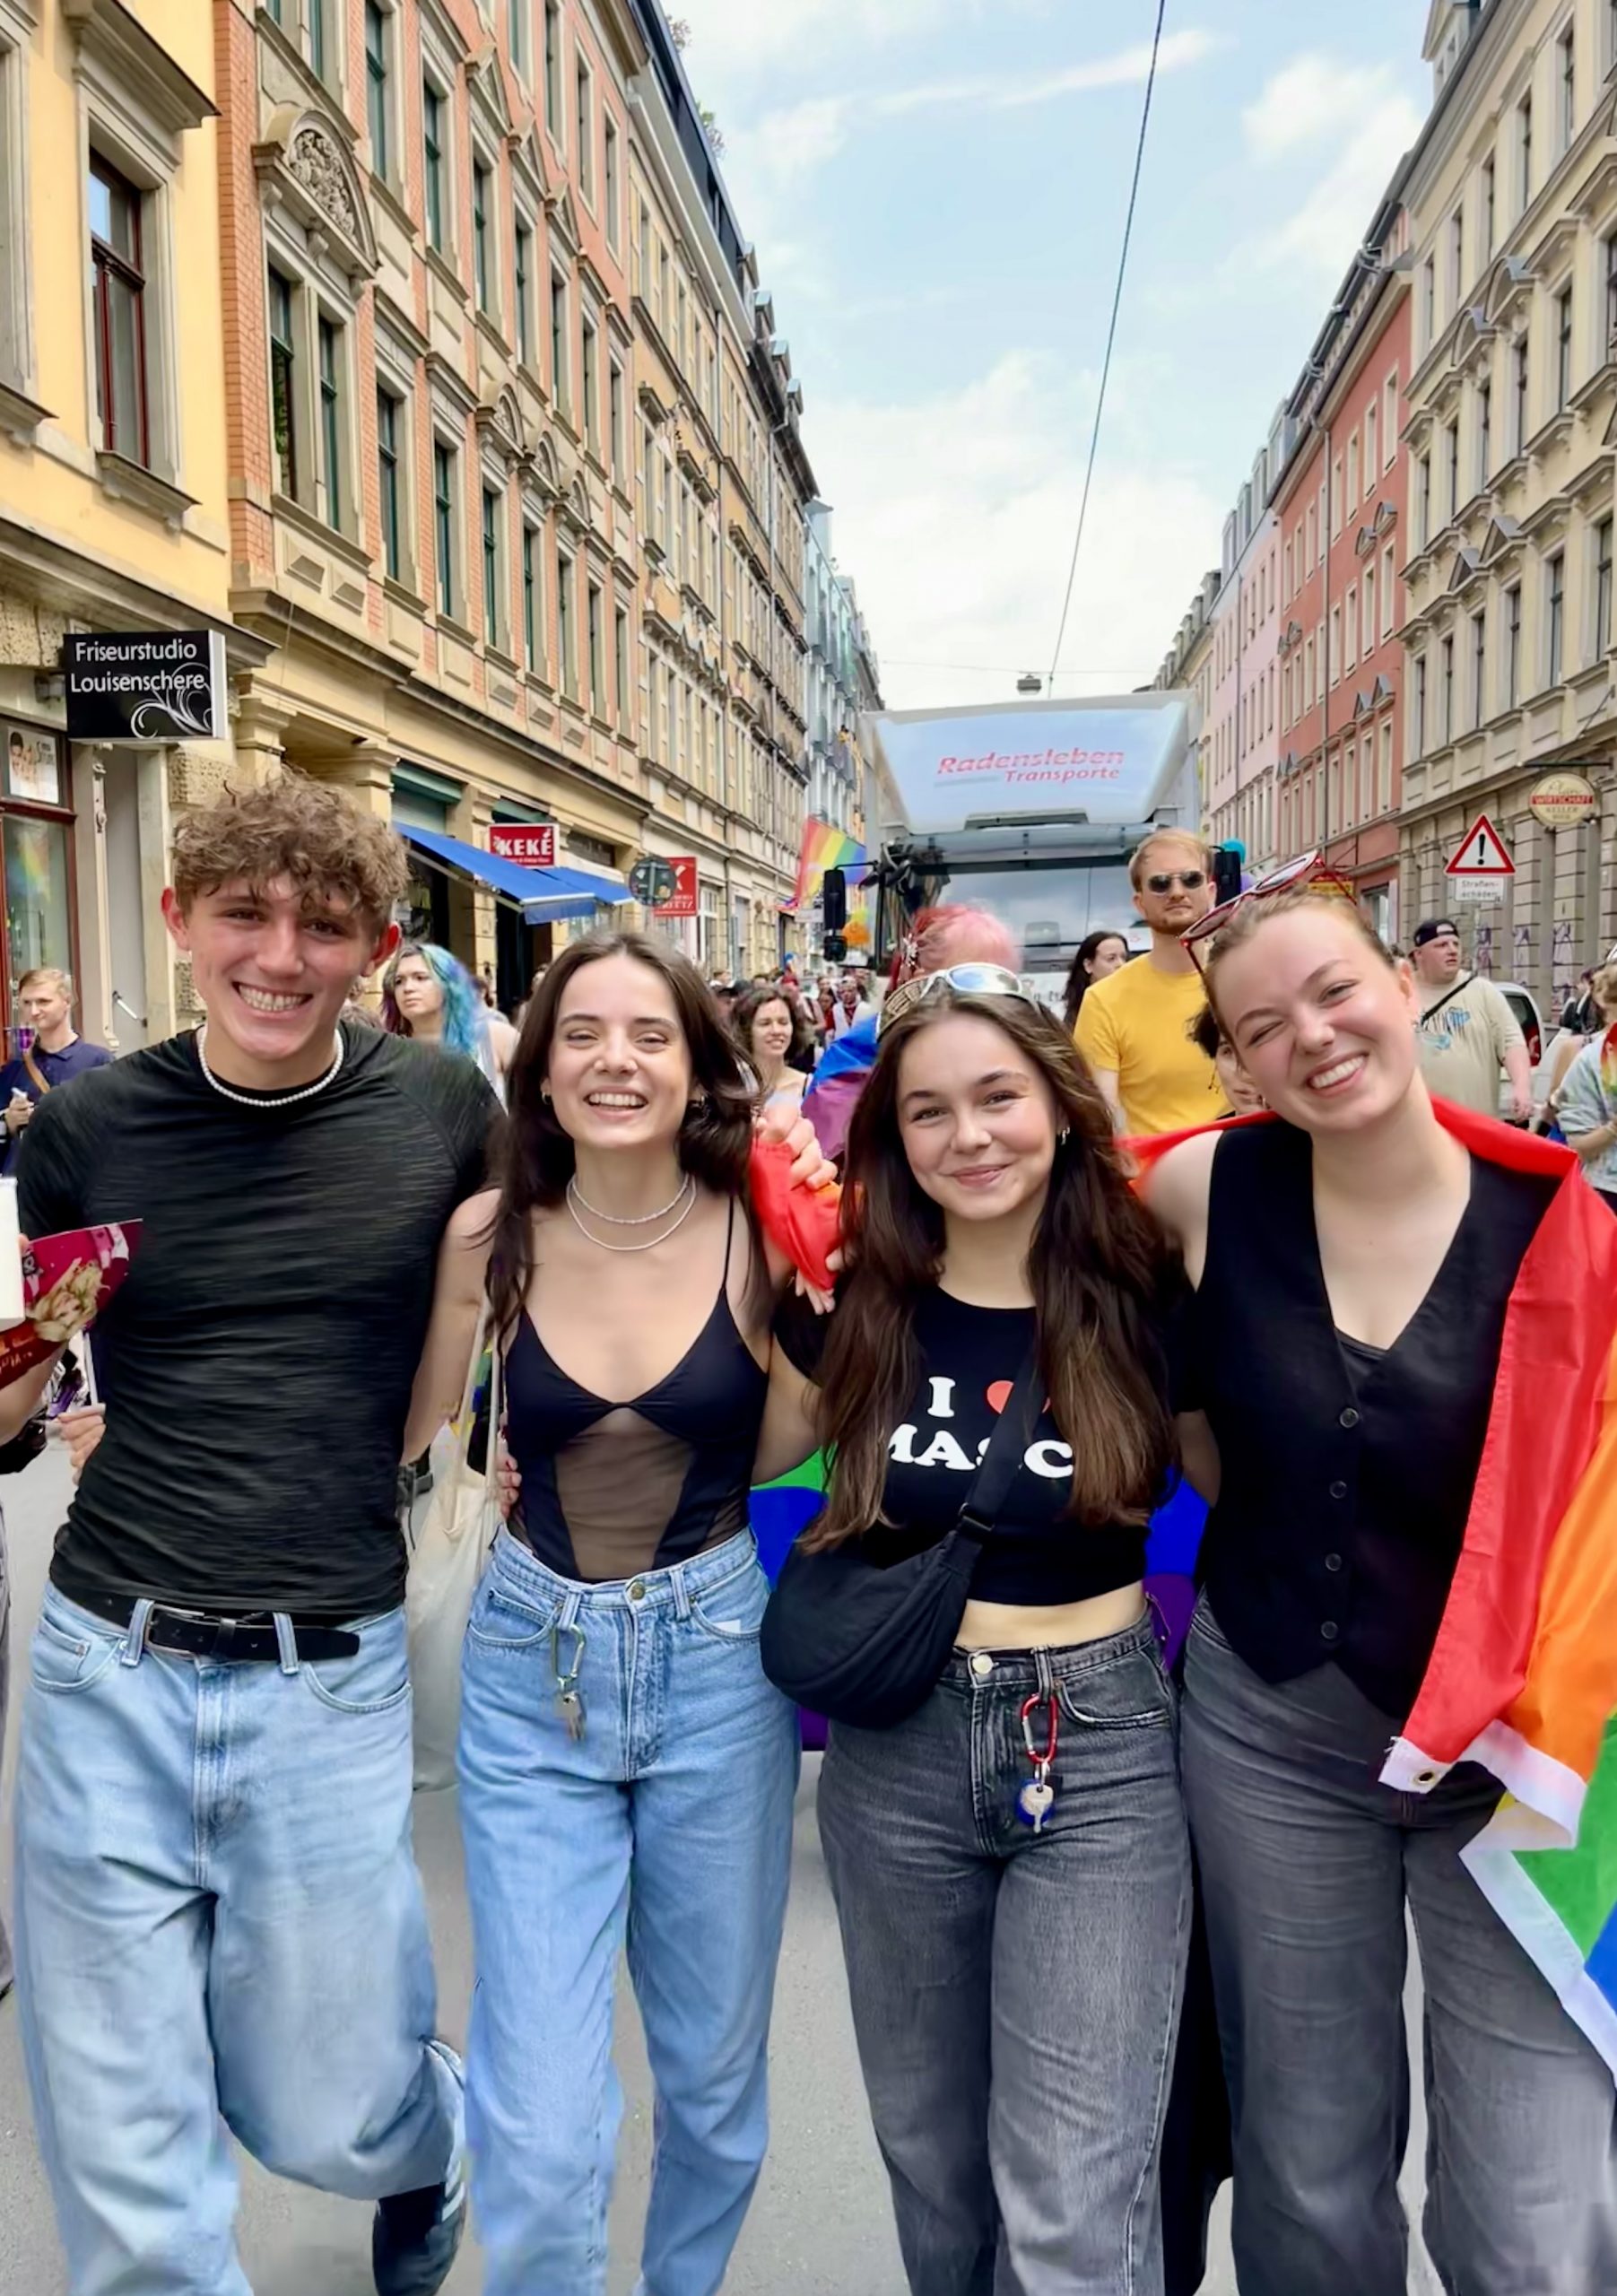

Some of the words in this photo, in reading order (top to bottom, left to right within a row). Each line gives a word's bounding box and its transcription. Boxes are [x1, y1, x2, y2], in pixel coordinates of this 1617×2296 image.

[75, 639, 197, 662] Friseurstudio
[71, 670, 204, 693] Louisenschere
[937, 747, 1125, 774] Radensleben
[1004, 766, 1120, 784] Transporte
[1534, 796, 1590, 804] WIRTSCHAFT
[927, 1376, 956, 1418] I
